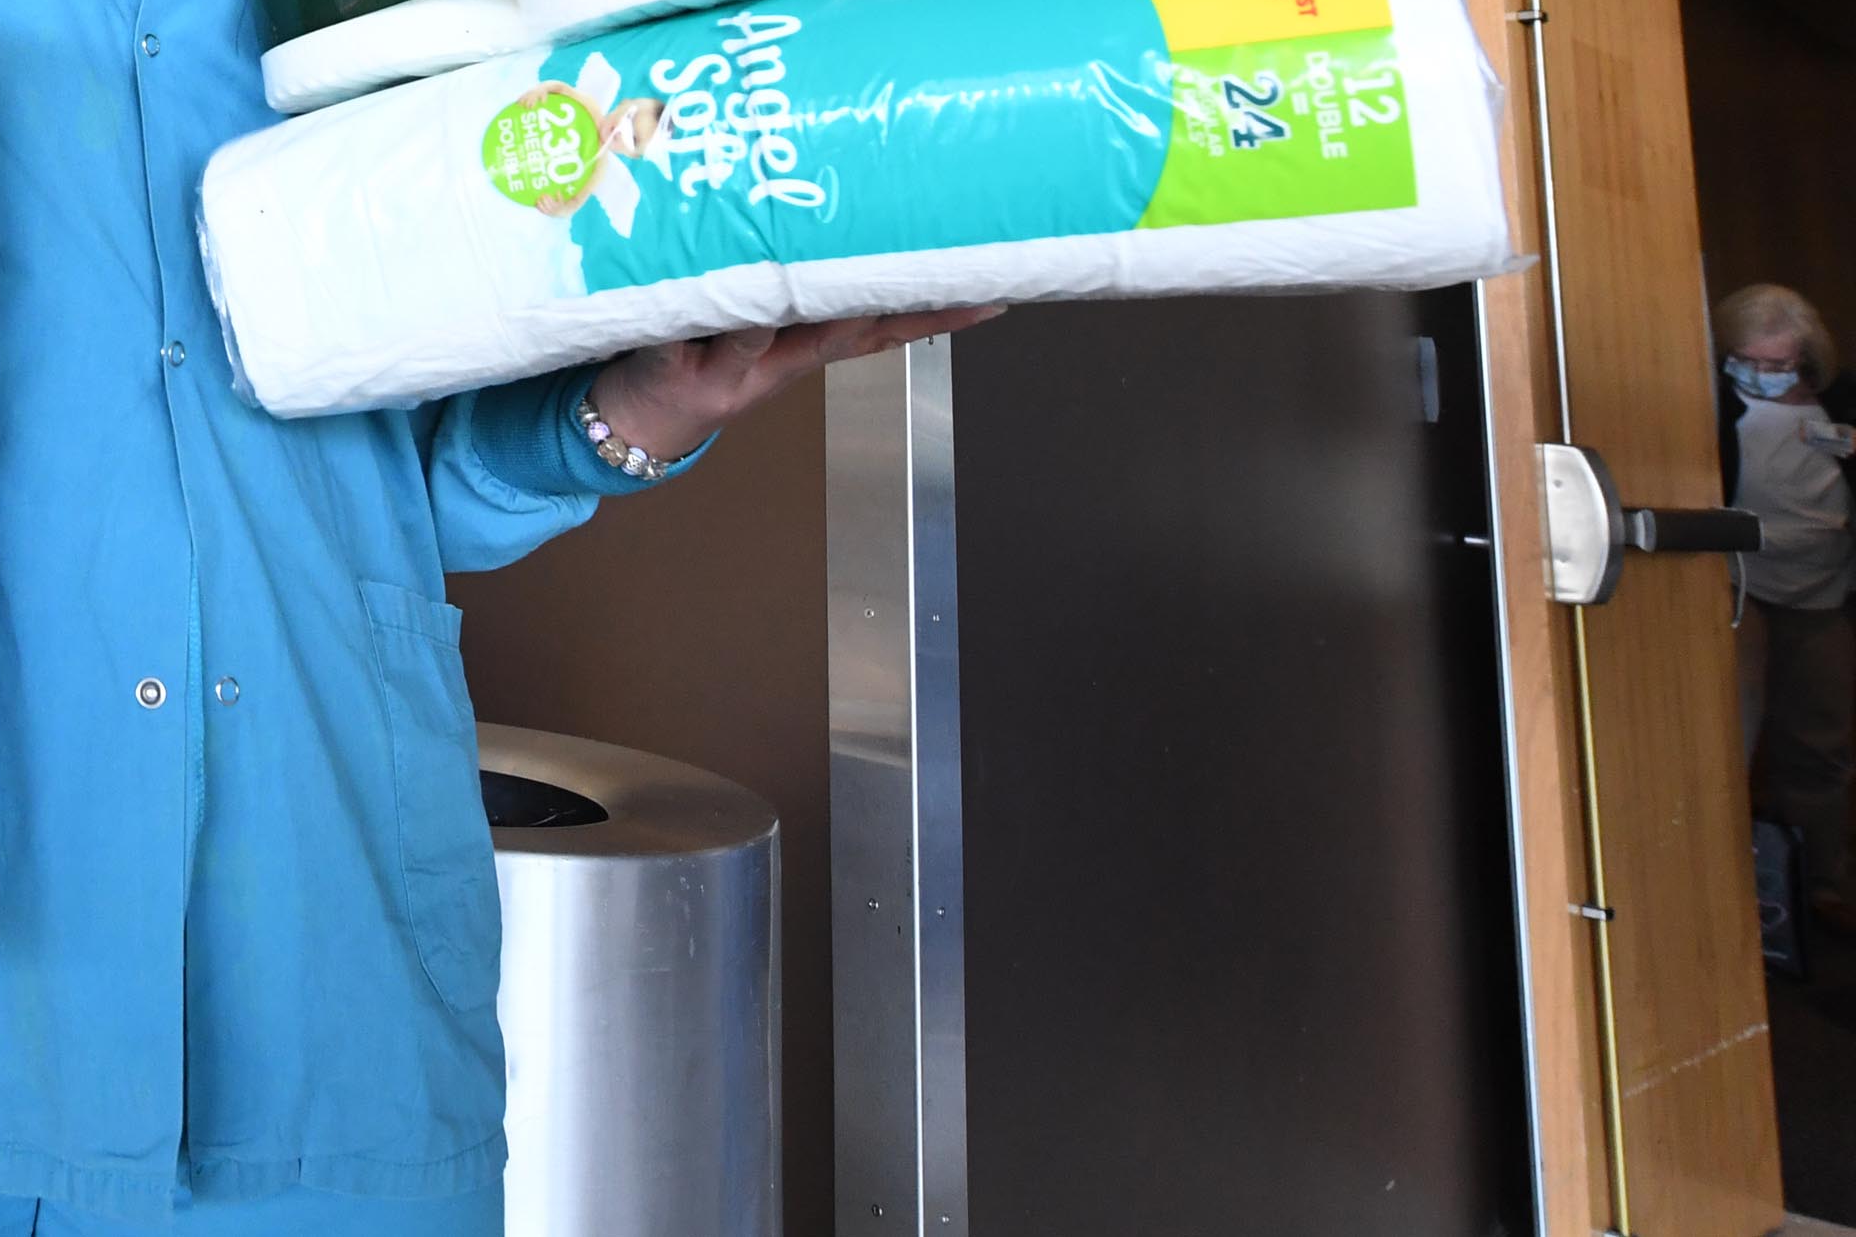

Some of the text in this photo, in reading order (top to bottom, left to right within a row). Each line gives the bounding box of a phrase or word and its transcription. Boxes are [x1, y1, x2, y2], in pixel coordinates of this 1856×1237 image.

[649, 53, 748, 198] Soft
[717, 11, 827, 208] Angel
[1221, 72, 1291, 150] 24
[1305, 51, 1349, 160] DOUBLE
[1343, 69, 1401, 128] 12
[497, 117, 526, 193] DOUBLE
[520, 110, 550, 190] SHEETS
